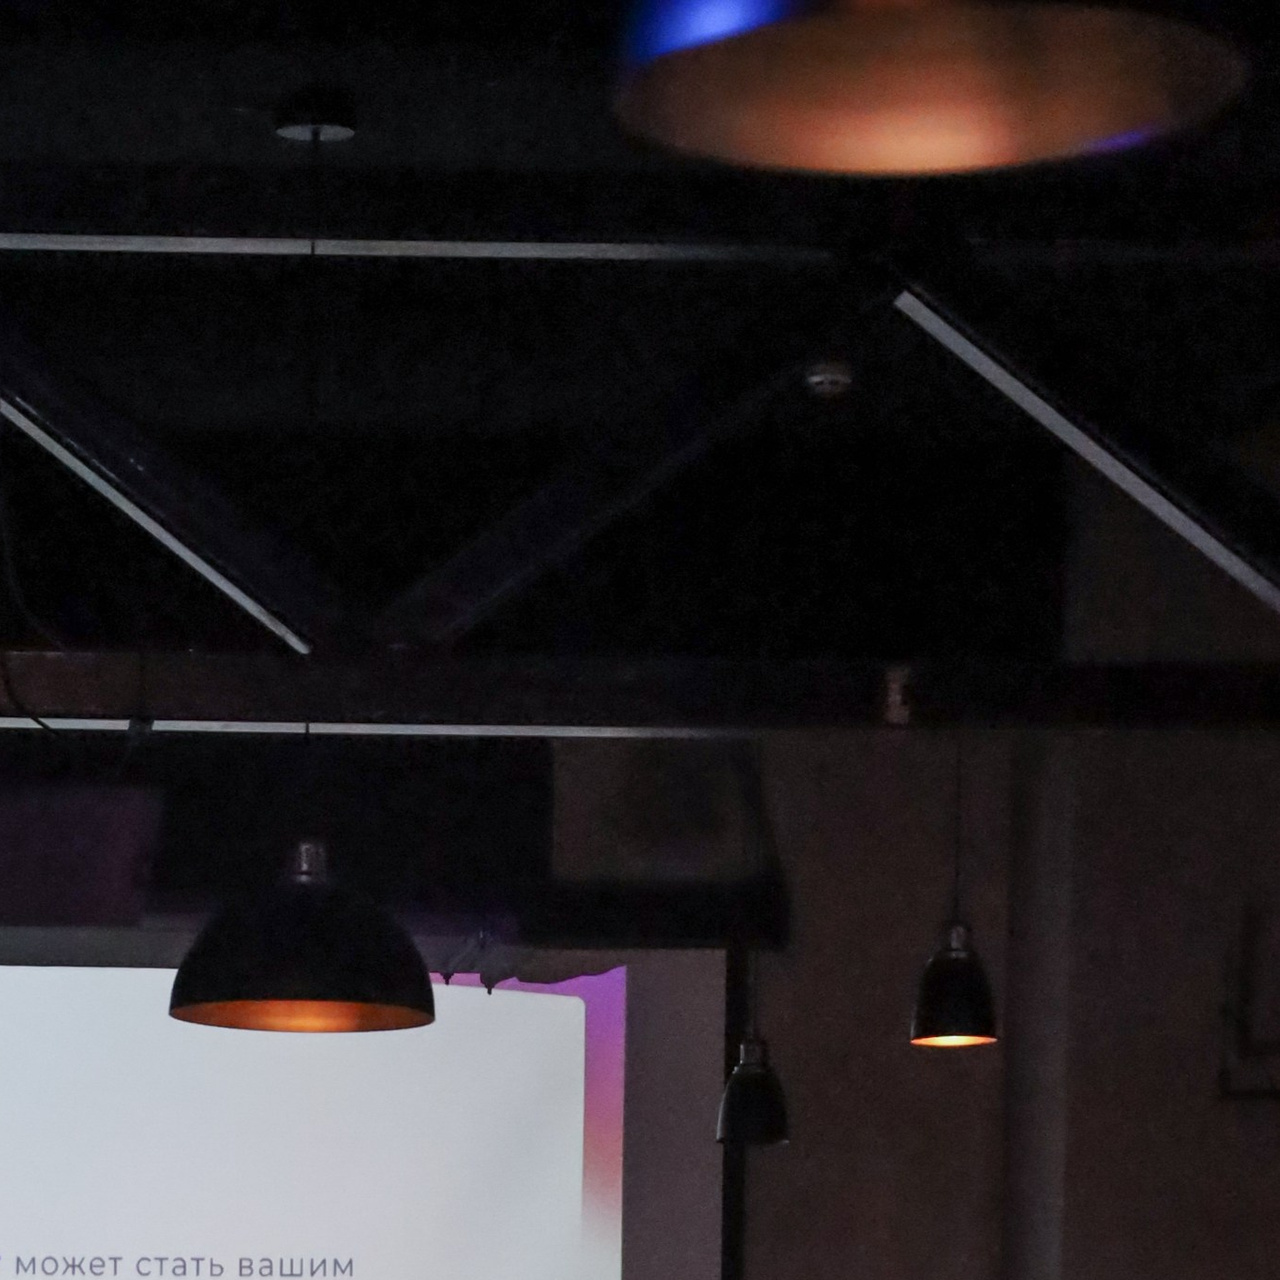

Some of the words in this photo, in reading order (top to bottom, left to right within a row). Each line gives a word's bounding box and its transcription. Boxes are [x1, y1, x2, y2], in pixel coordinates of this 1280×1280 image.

[14, 1254, 124, 1278] может
[134, 1255, 225, 1278] стать
[237, 1256, 354, 1279] вашим
